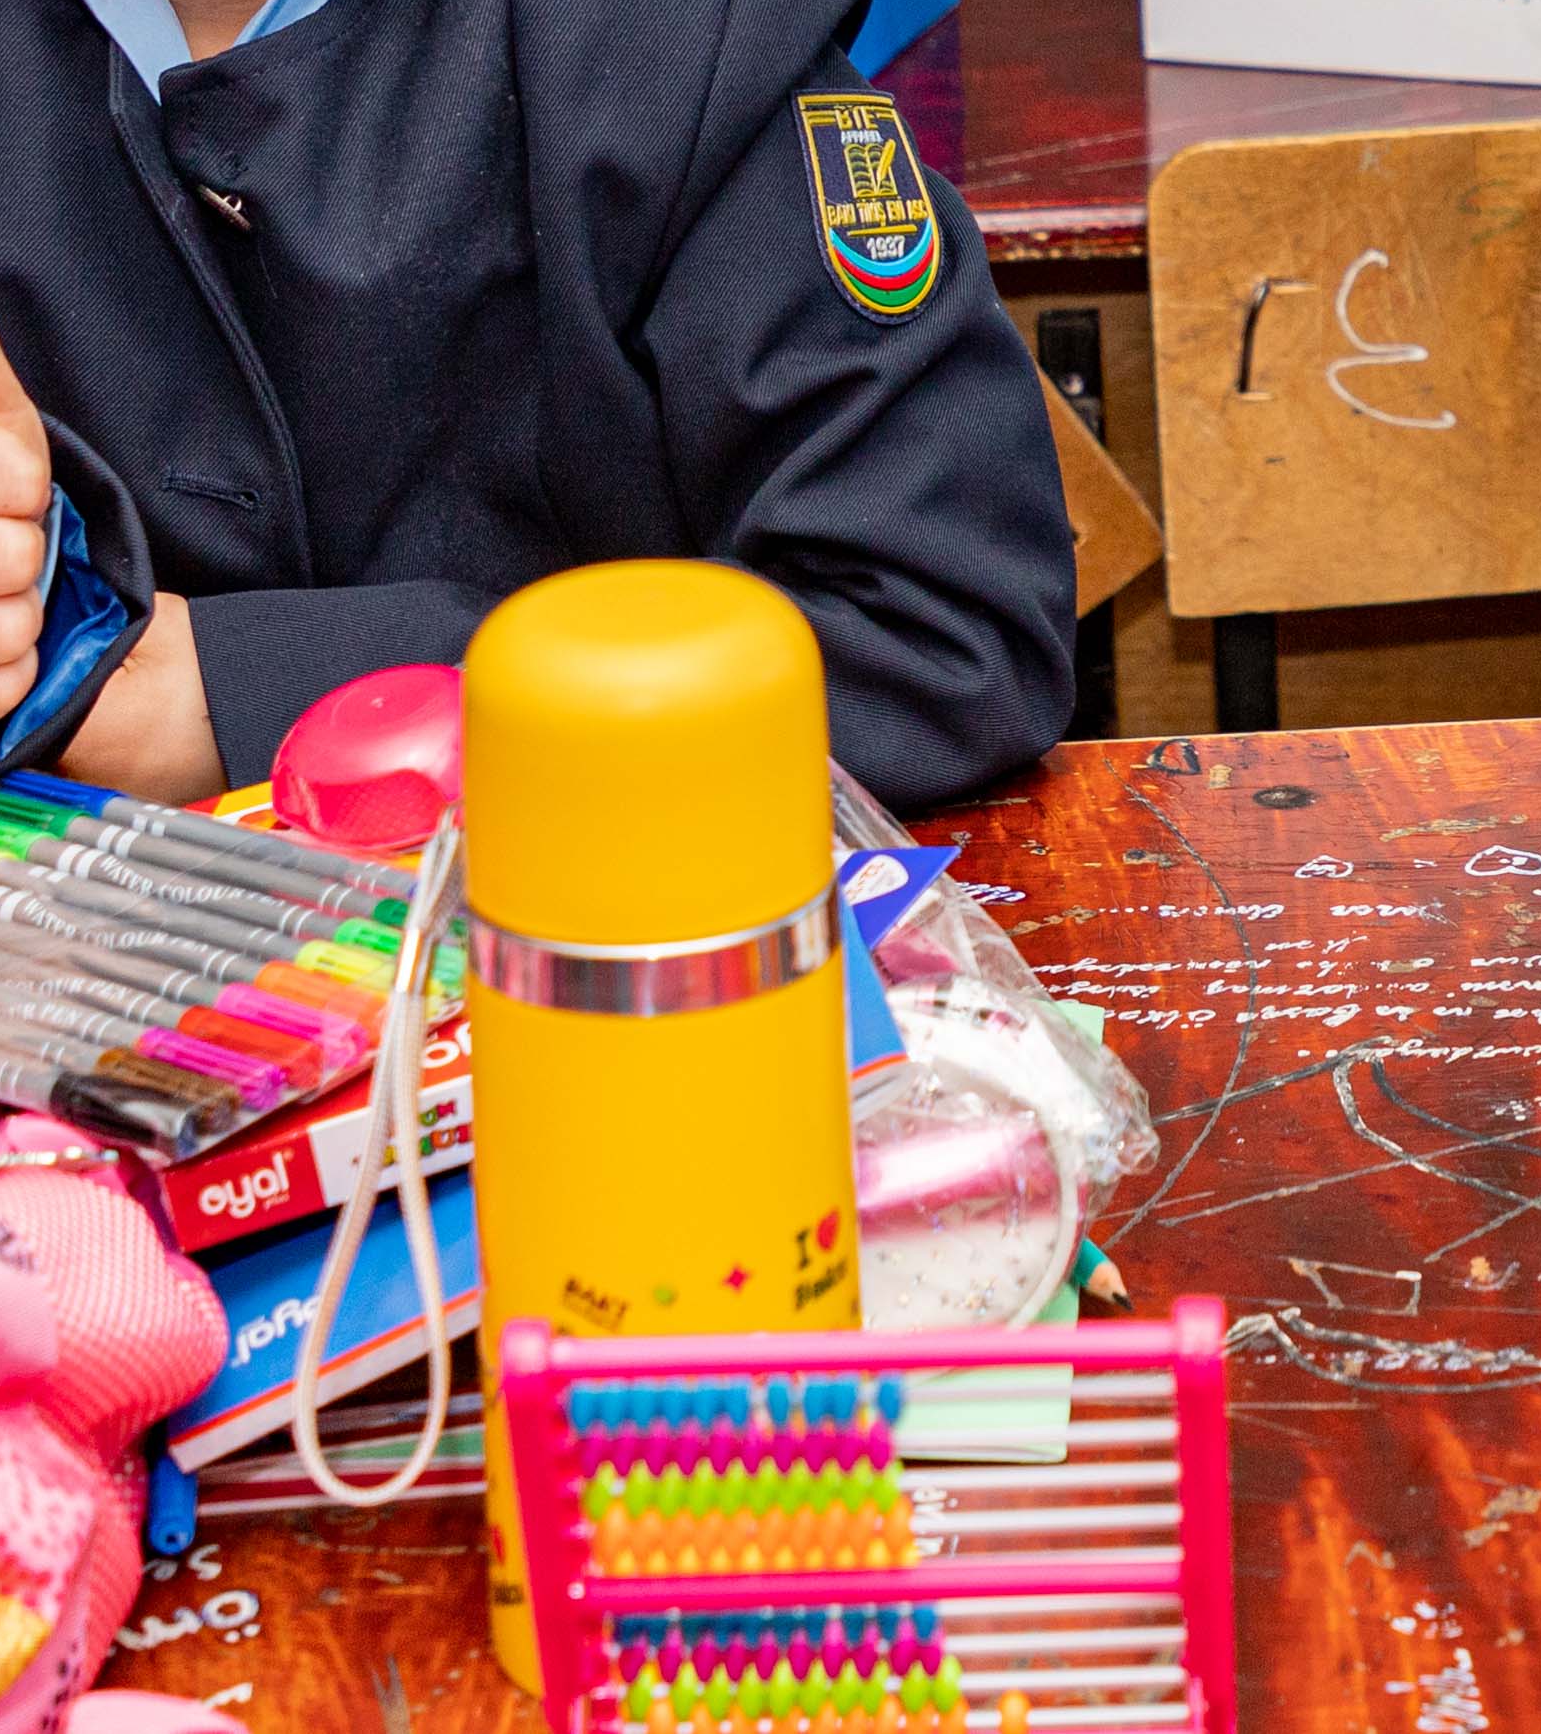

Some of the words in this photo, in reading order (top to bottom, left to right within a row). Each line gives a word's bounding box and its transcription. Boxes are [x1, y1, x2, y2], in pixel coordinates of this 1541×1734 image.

[866, 235, 907, 259] 1937
[99, 854, 155, 898] WATER
[198, 1151, 291, 1219] oyal
